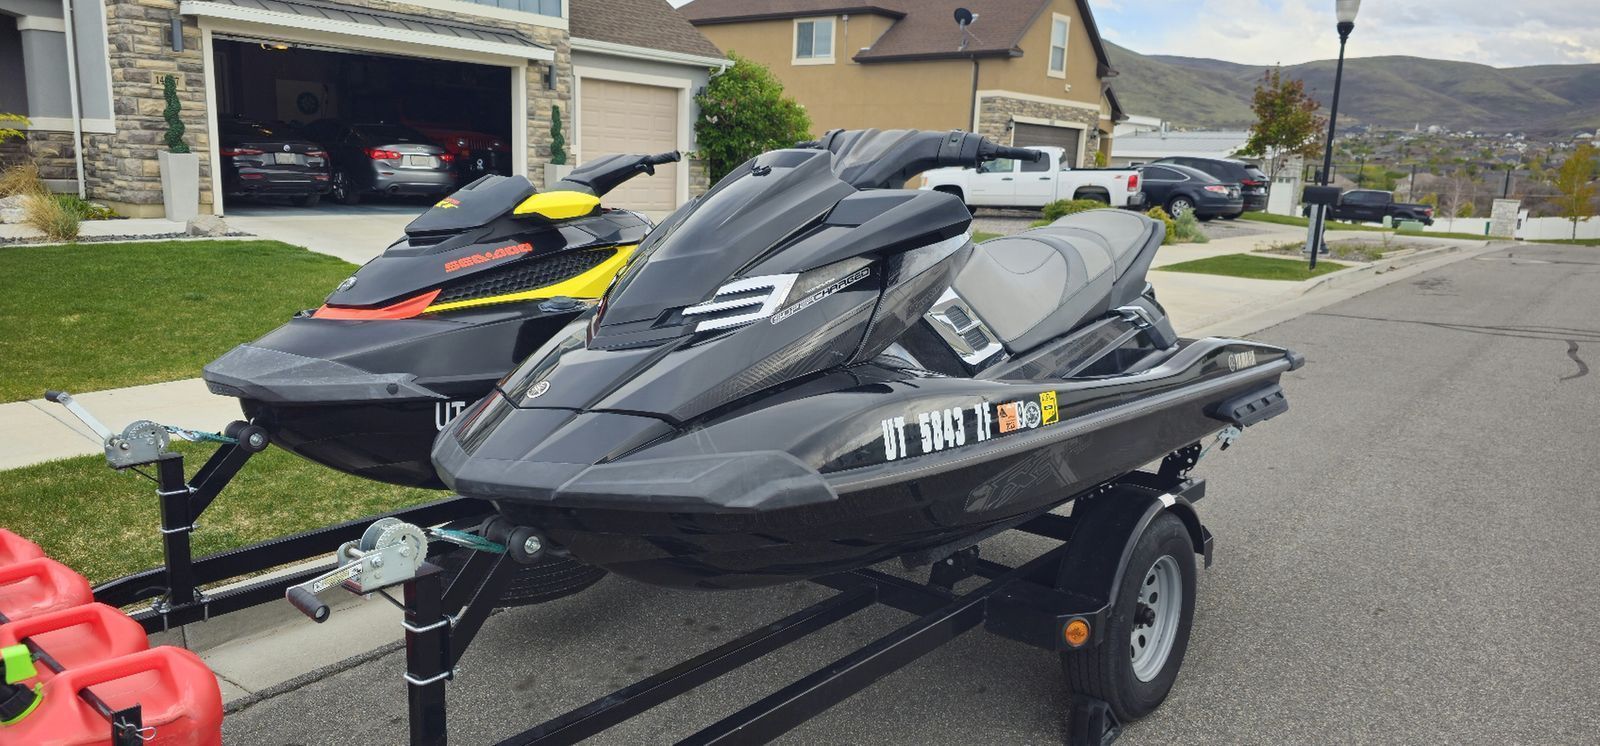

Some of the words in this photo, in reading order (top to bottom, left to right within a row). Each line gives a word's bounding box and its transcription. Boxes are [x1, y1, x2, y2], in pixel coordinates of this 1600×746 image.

[435, 401, 466, 431] UT
[881, 416, 907, 461] UT
[918, 406, 966, 453] 5843
